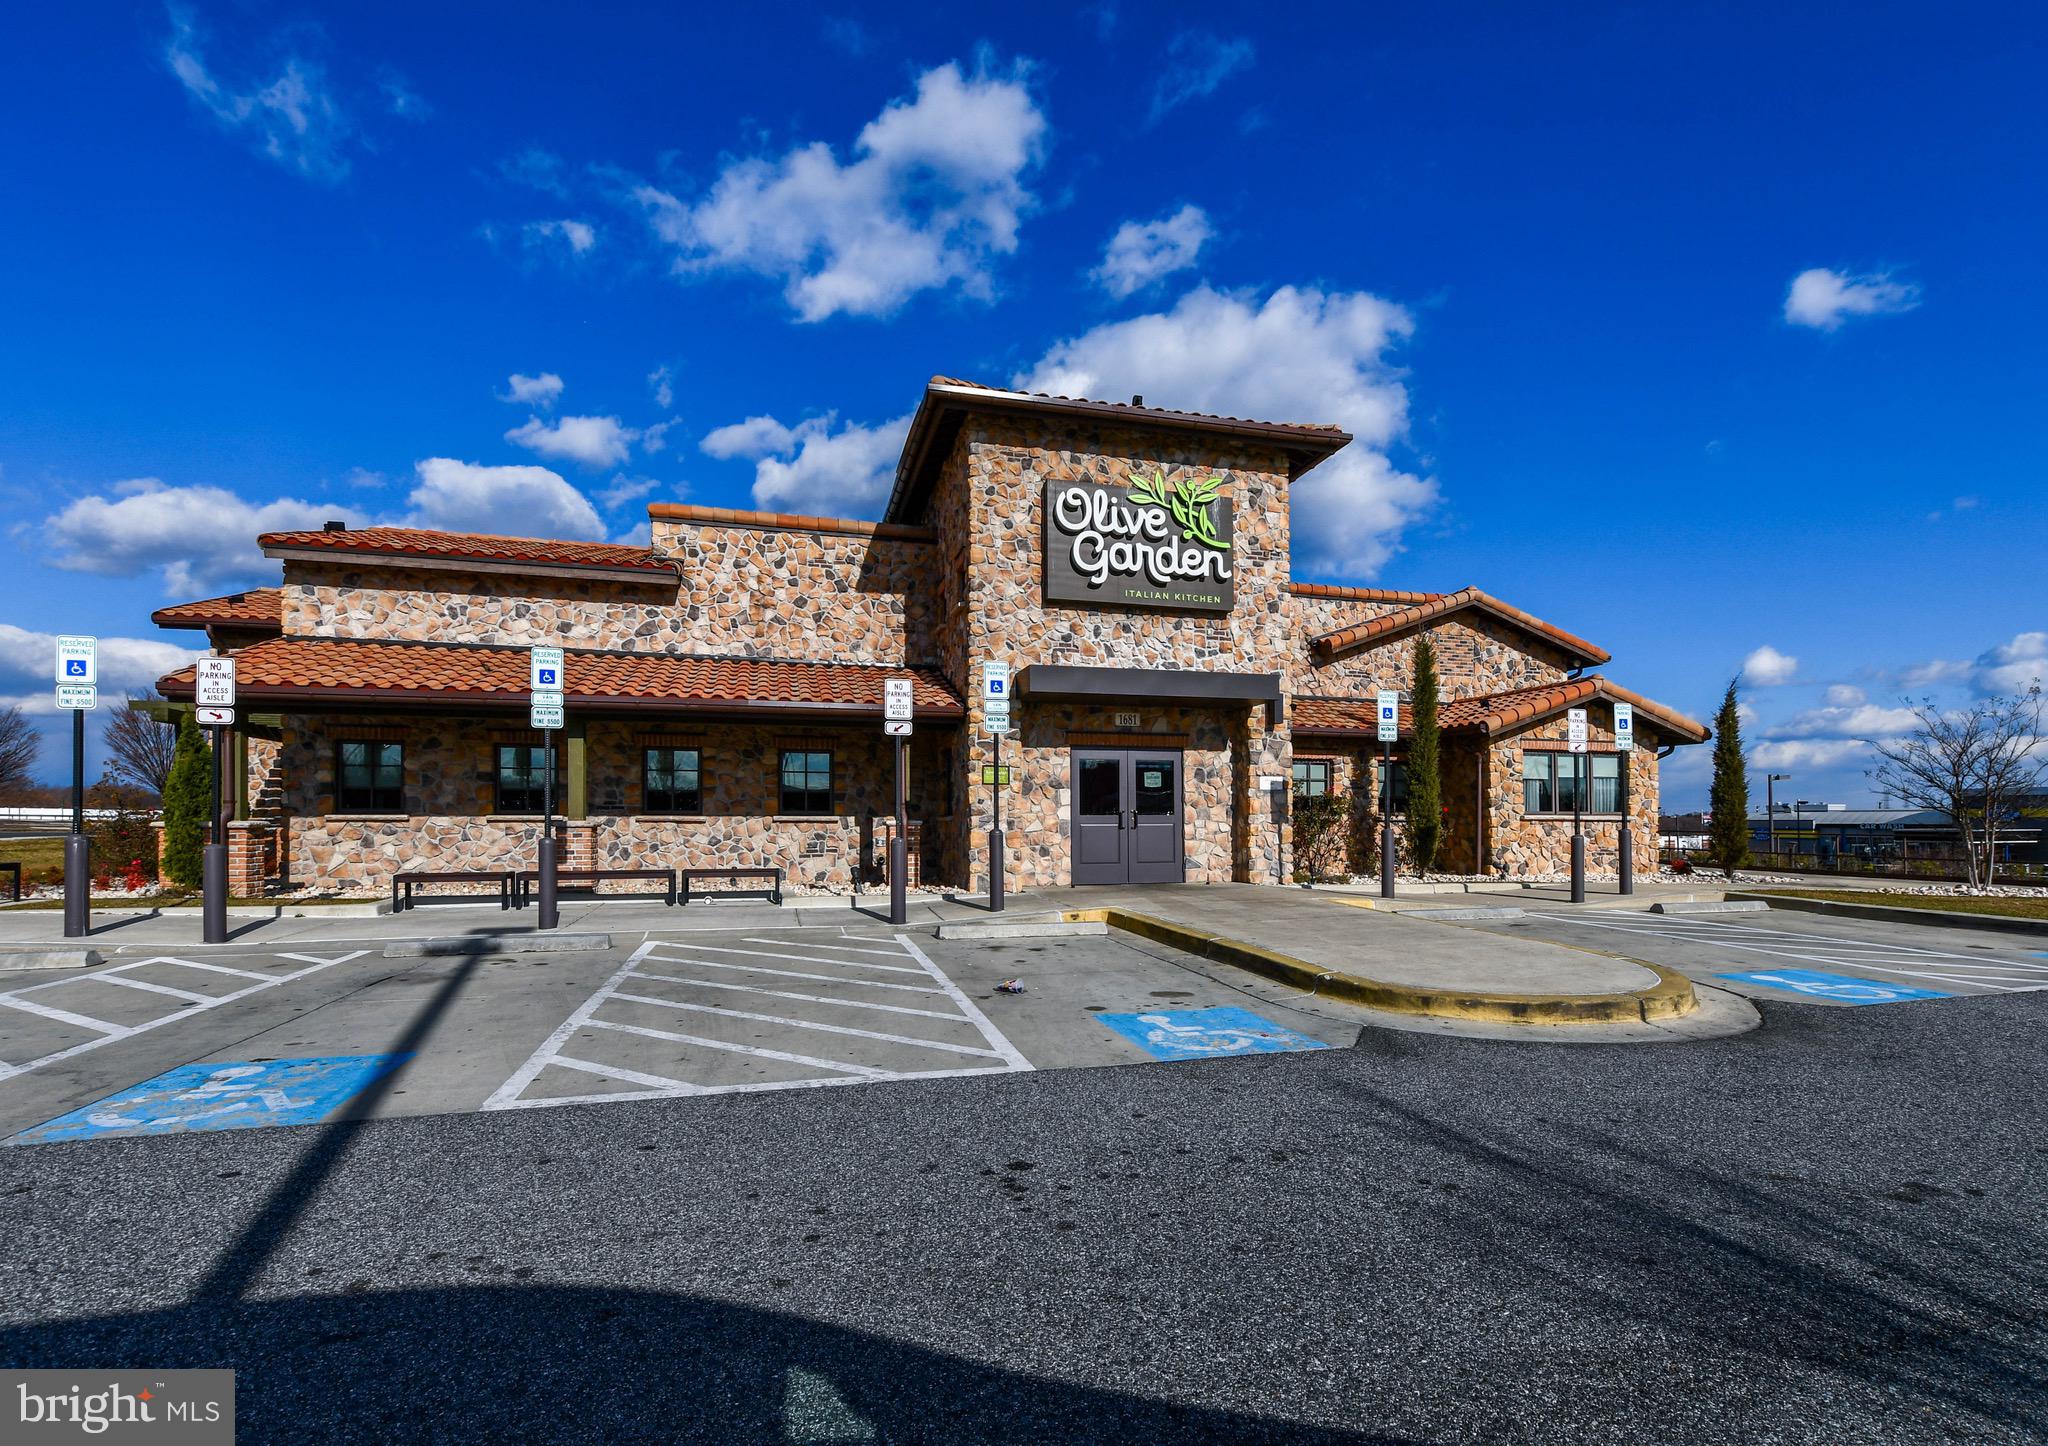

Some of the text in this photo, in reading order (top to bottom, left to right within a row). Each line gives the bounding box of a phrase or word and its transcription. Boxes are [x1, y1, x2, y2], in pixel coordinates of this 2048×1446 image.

[1056, 487, 1169, 537] Olive
[1073, 530, 1232, 584] Garden
[1125, 589, 1221, 603] ITALIAN KITCHEN
[60, 640, 94, 648] RESERVED
[533, 651, 561, 659] RESERVED
[210, 663, 222, 671] NO
[200, 672, 232, 680] PARKING
[1119, 714, 1137, 725] 1681
